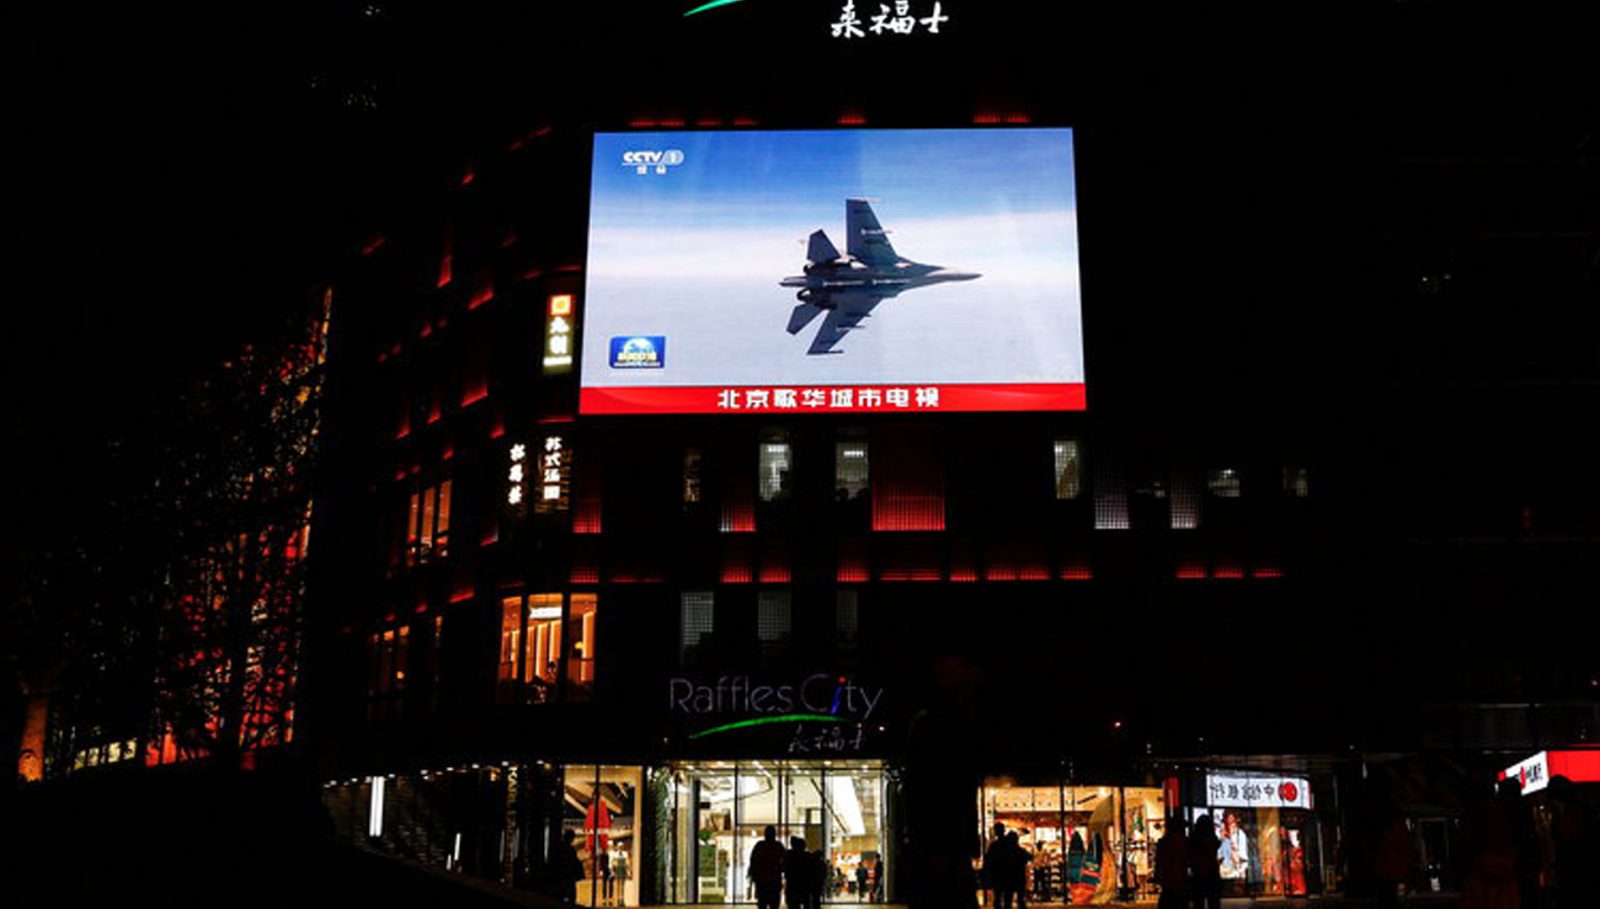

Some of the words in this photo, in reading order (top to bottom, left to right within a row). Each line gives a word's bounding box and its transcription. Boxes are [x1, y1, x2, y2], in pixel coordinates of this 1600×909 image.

[623, 151, 663, 163] CCTV
[717, 387, 940, 409] 北京歌华城市电视
[669, 675, 793, 713] Raffles
[800, 672, 884, 720] City
